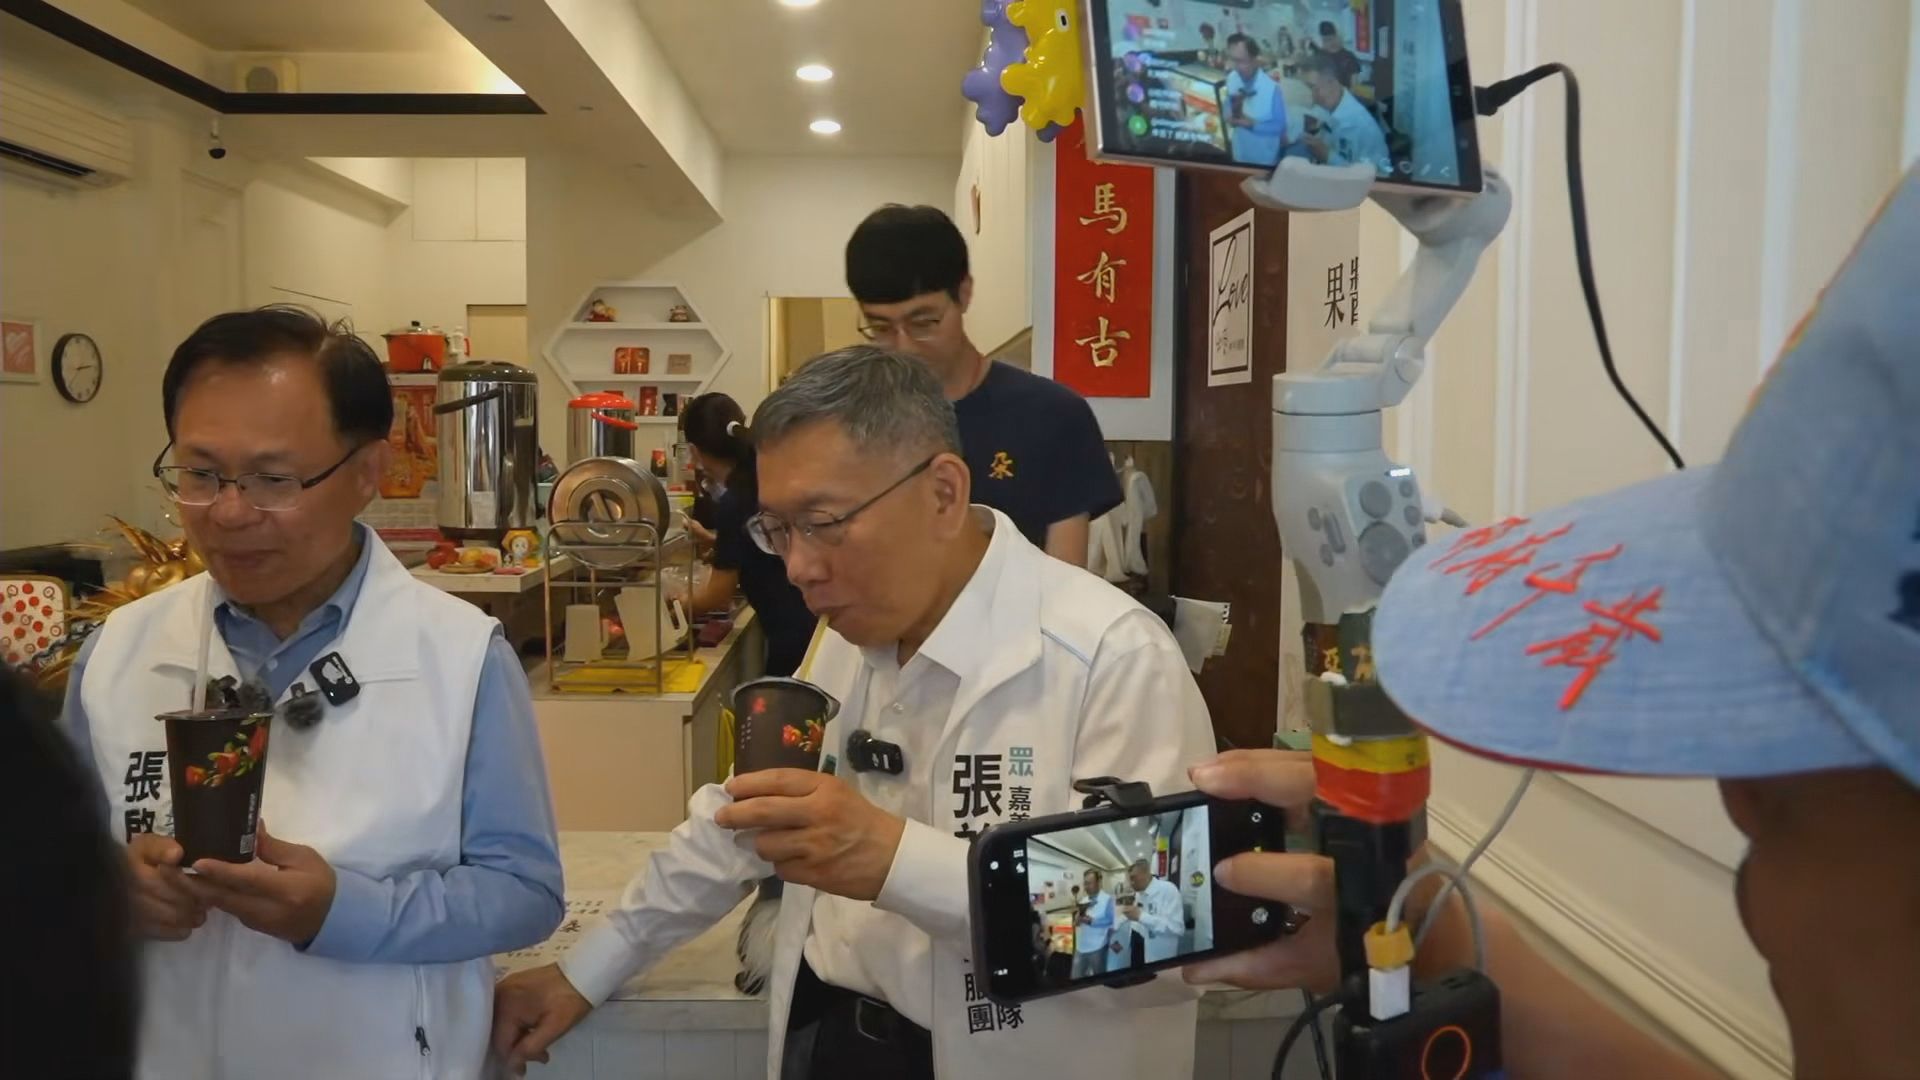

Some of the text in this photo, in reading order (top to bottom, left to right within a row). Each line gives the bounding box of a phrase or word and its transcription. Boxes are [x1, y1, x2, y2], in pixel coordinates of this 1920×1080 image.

[1075, 140, 1131, 368] 馬有吉
[1213, 235, 1249, 327] Love
